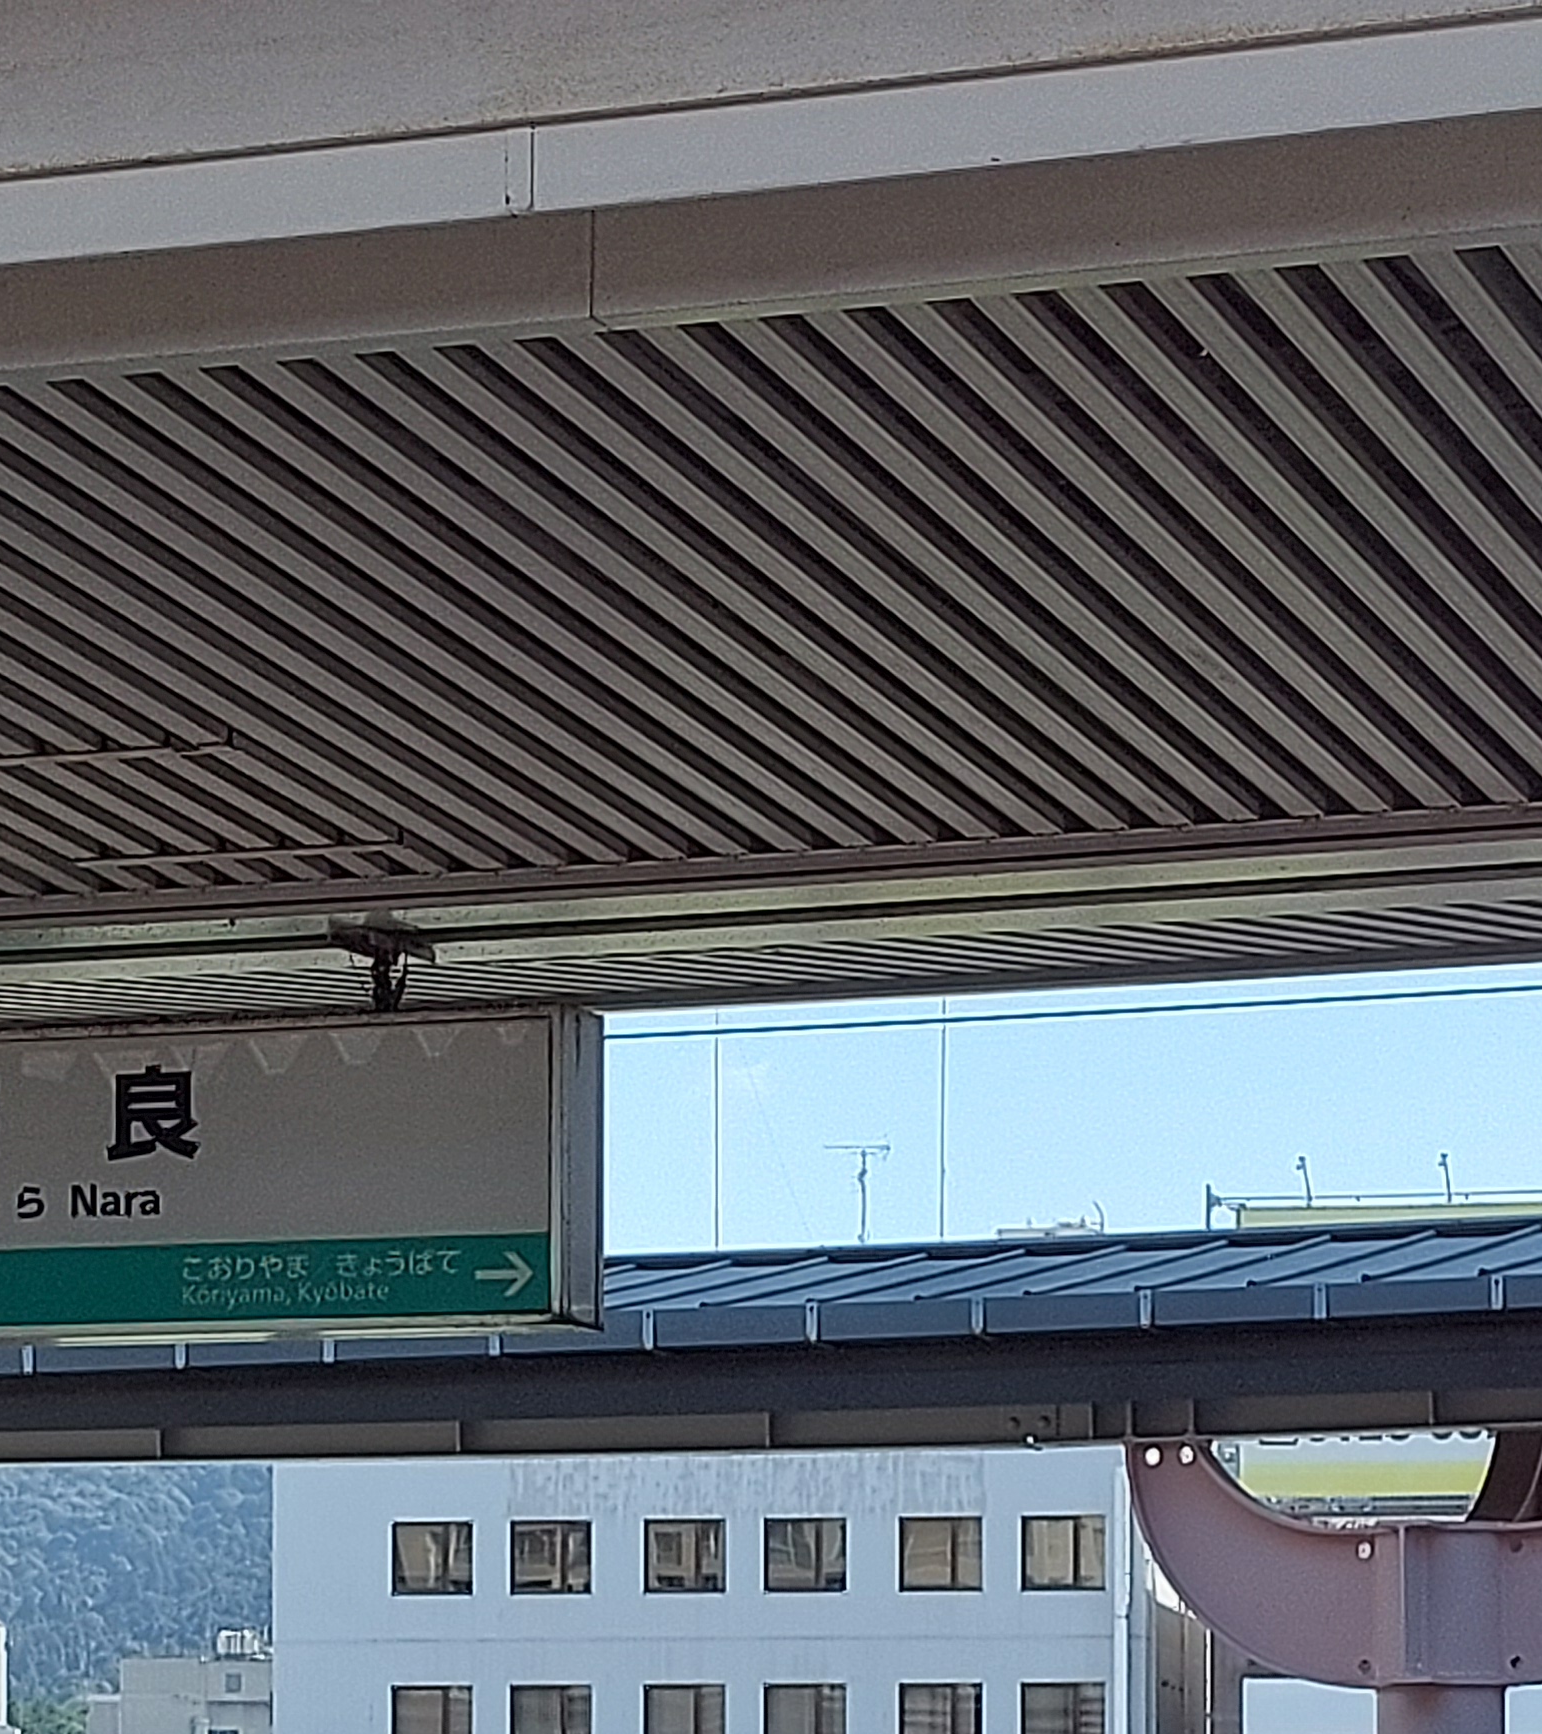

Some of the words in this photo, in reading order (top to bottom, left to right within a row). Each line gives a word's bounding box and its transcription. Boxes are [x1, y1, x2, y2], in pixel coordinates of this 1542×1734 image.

[70, 1184, 161, 1219] Nara
[182, 1254, 309, 1280] こおりやま
[336, 1250, 461, 1278] きょうばて
